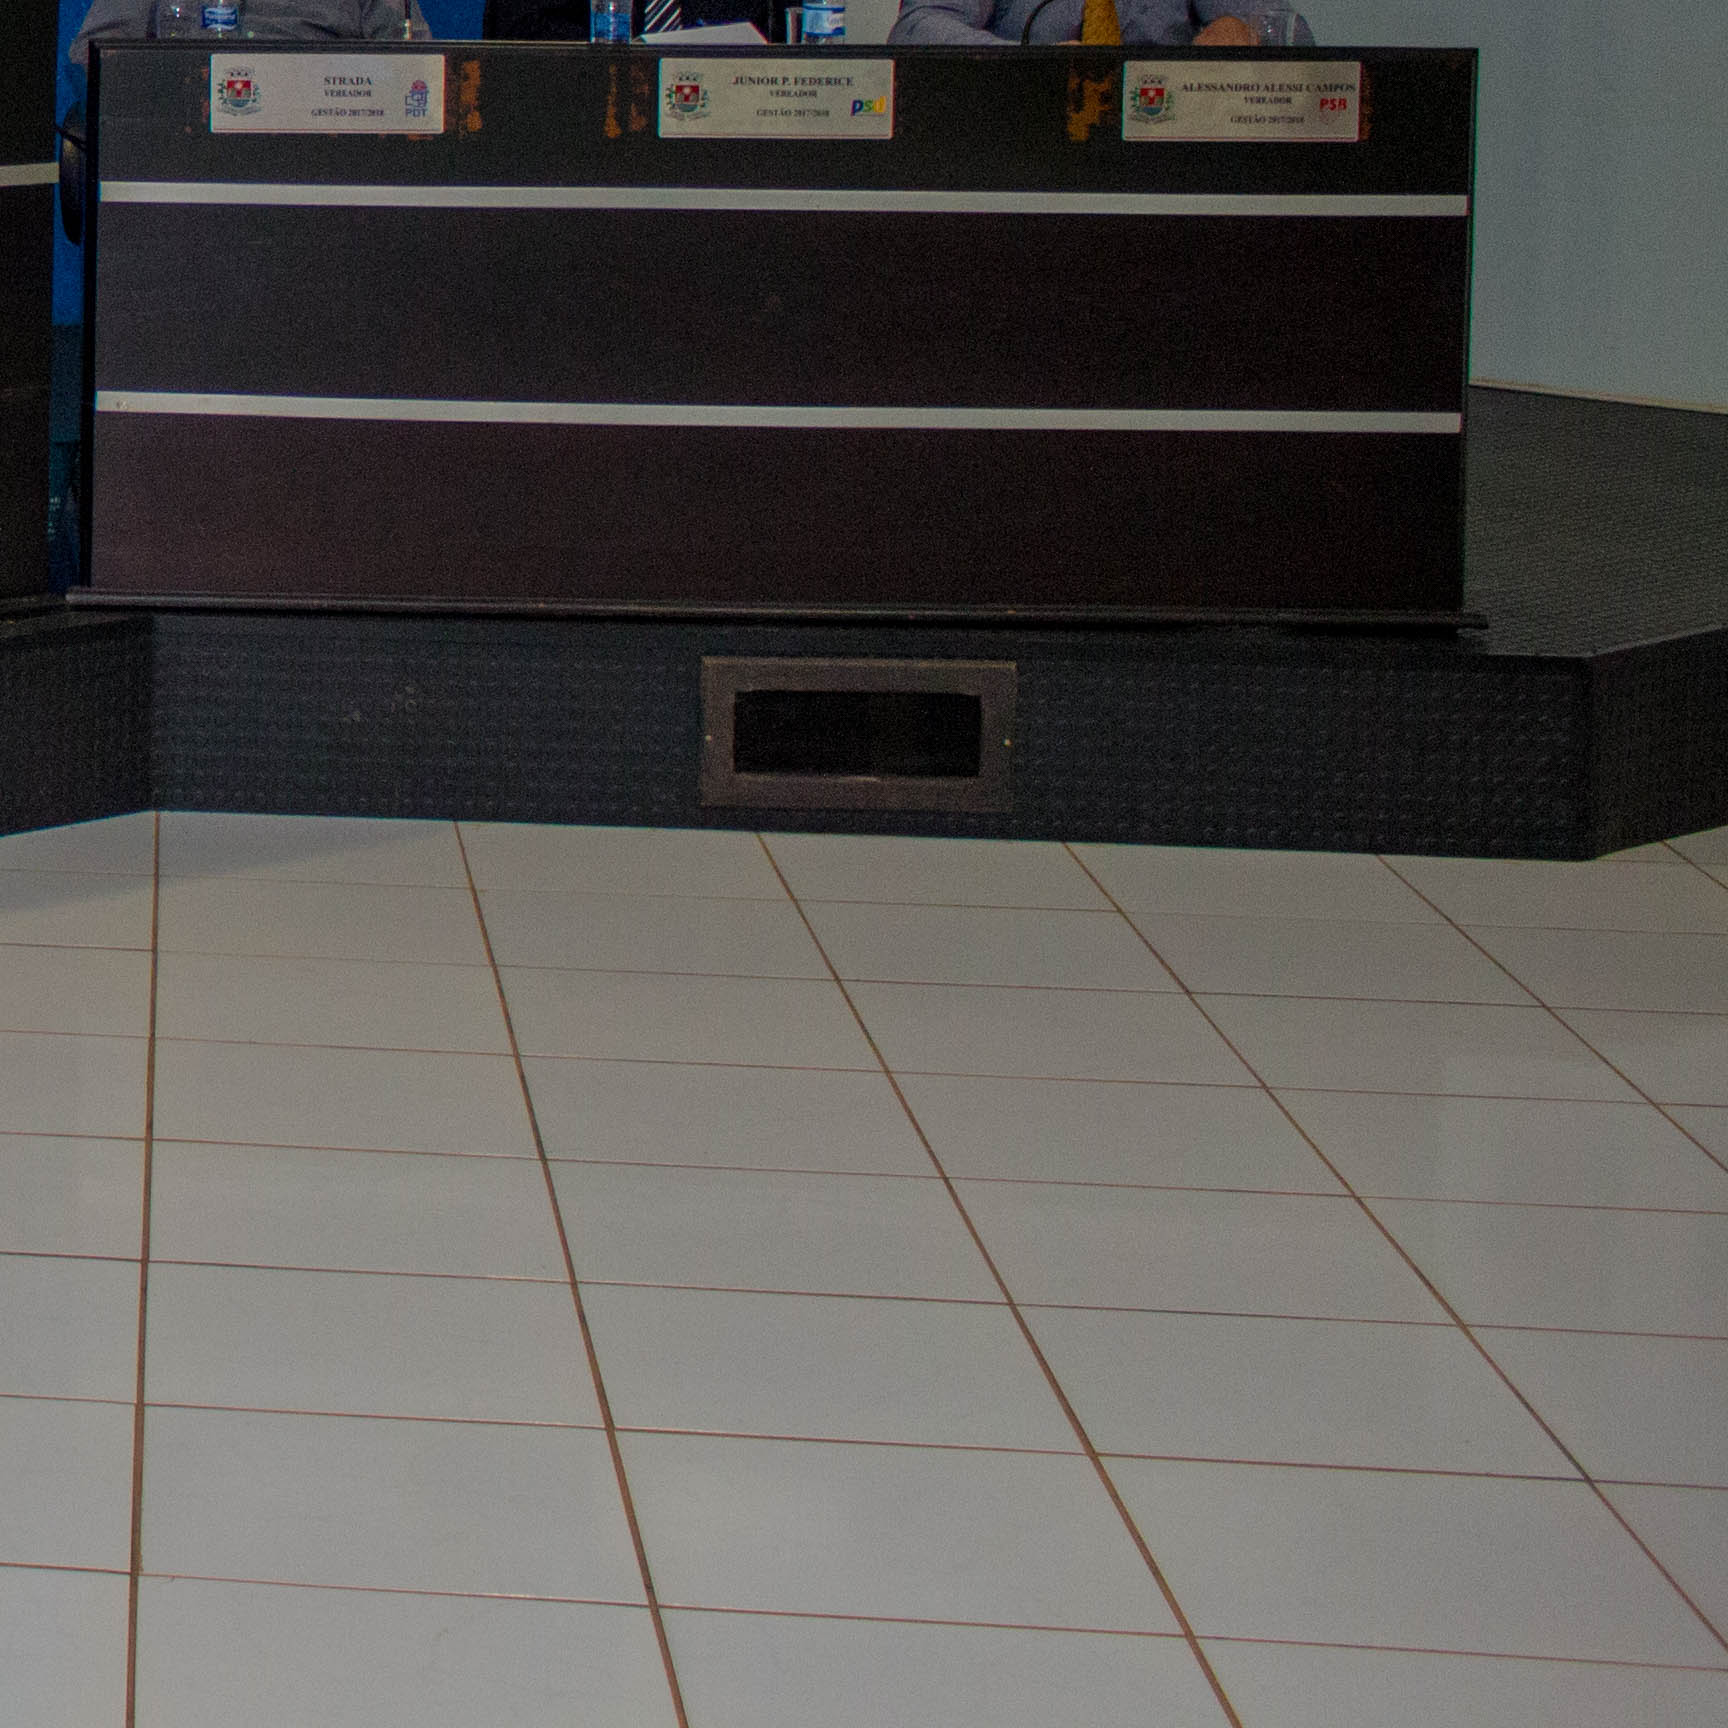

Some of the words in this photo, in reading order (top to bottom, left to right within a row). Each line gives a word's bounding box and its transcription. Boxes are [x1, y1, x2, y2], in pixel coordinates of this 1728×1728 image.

[324, 77, 372, 86] STRADA
[794, 76, 854, 87] FEDERICE
[1182, 83, 1260, 92] ALESSANDRO
[1305, 83, 1356, 92] CAMPOS
